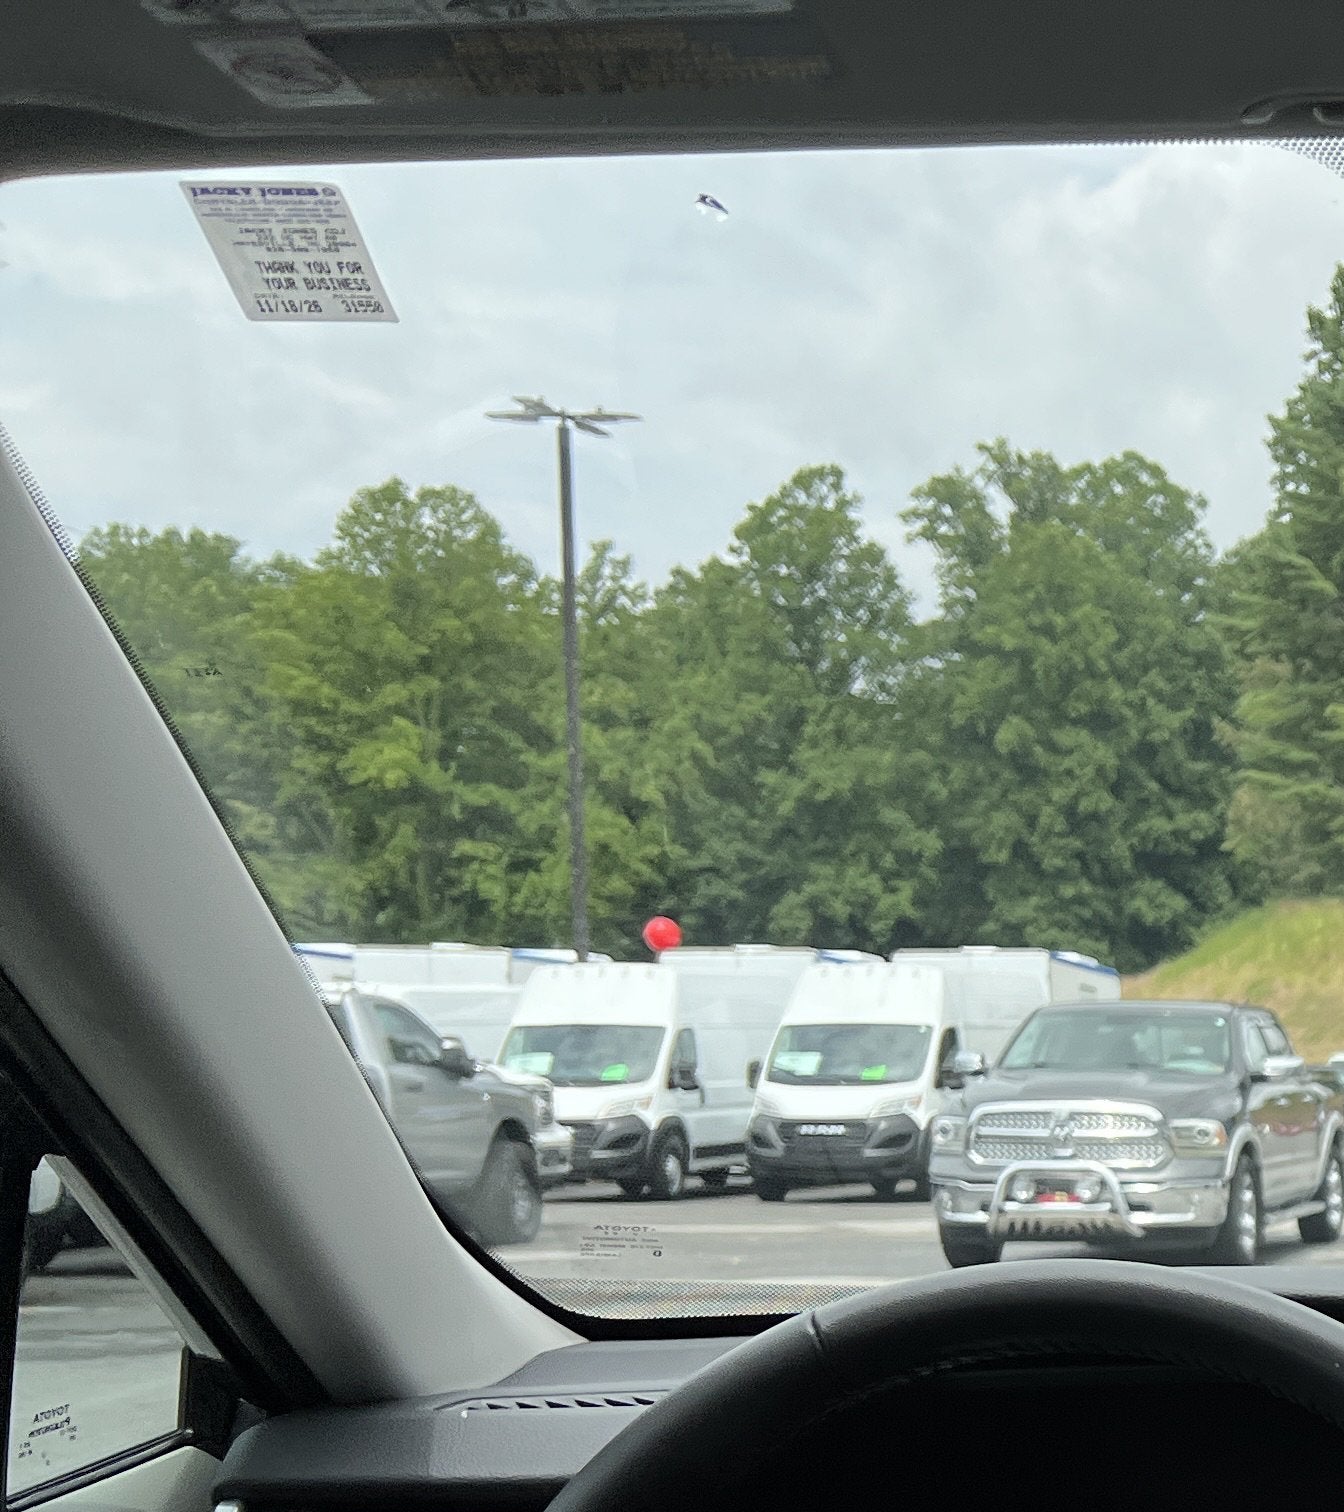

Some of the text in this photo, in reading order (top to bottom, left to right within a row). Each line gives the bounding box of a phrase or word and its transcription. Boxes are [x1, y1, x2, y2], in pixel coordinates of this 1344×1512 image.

[254, 260, 363, 275] THANK YOU FOR
[263, 277, 372, 292] YOUR BUSINESS
